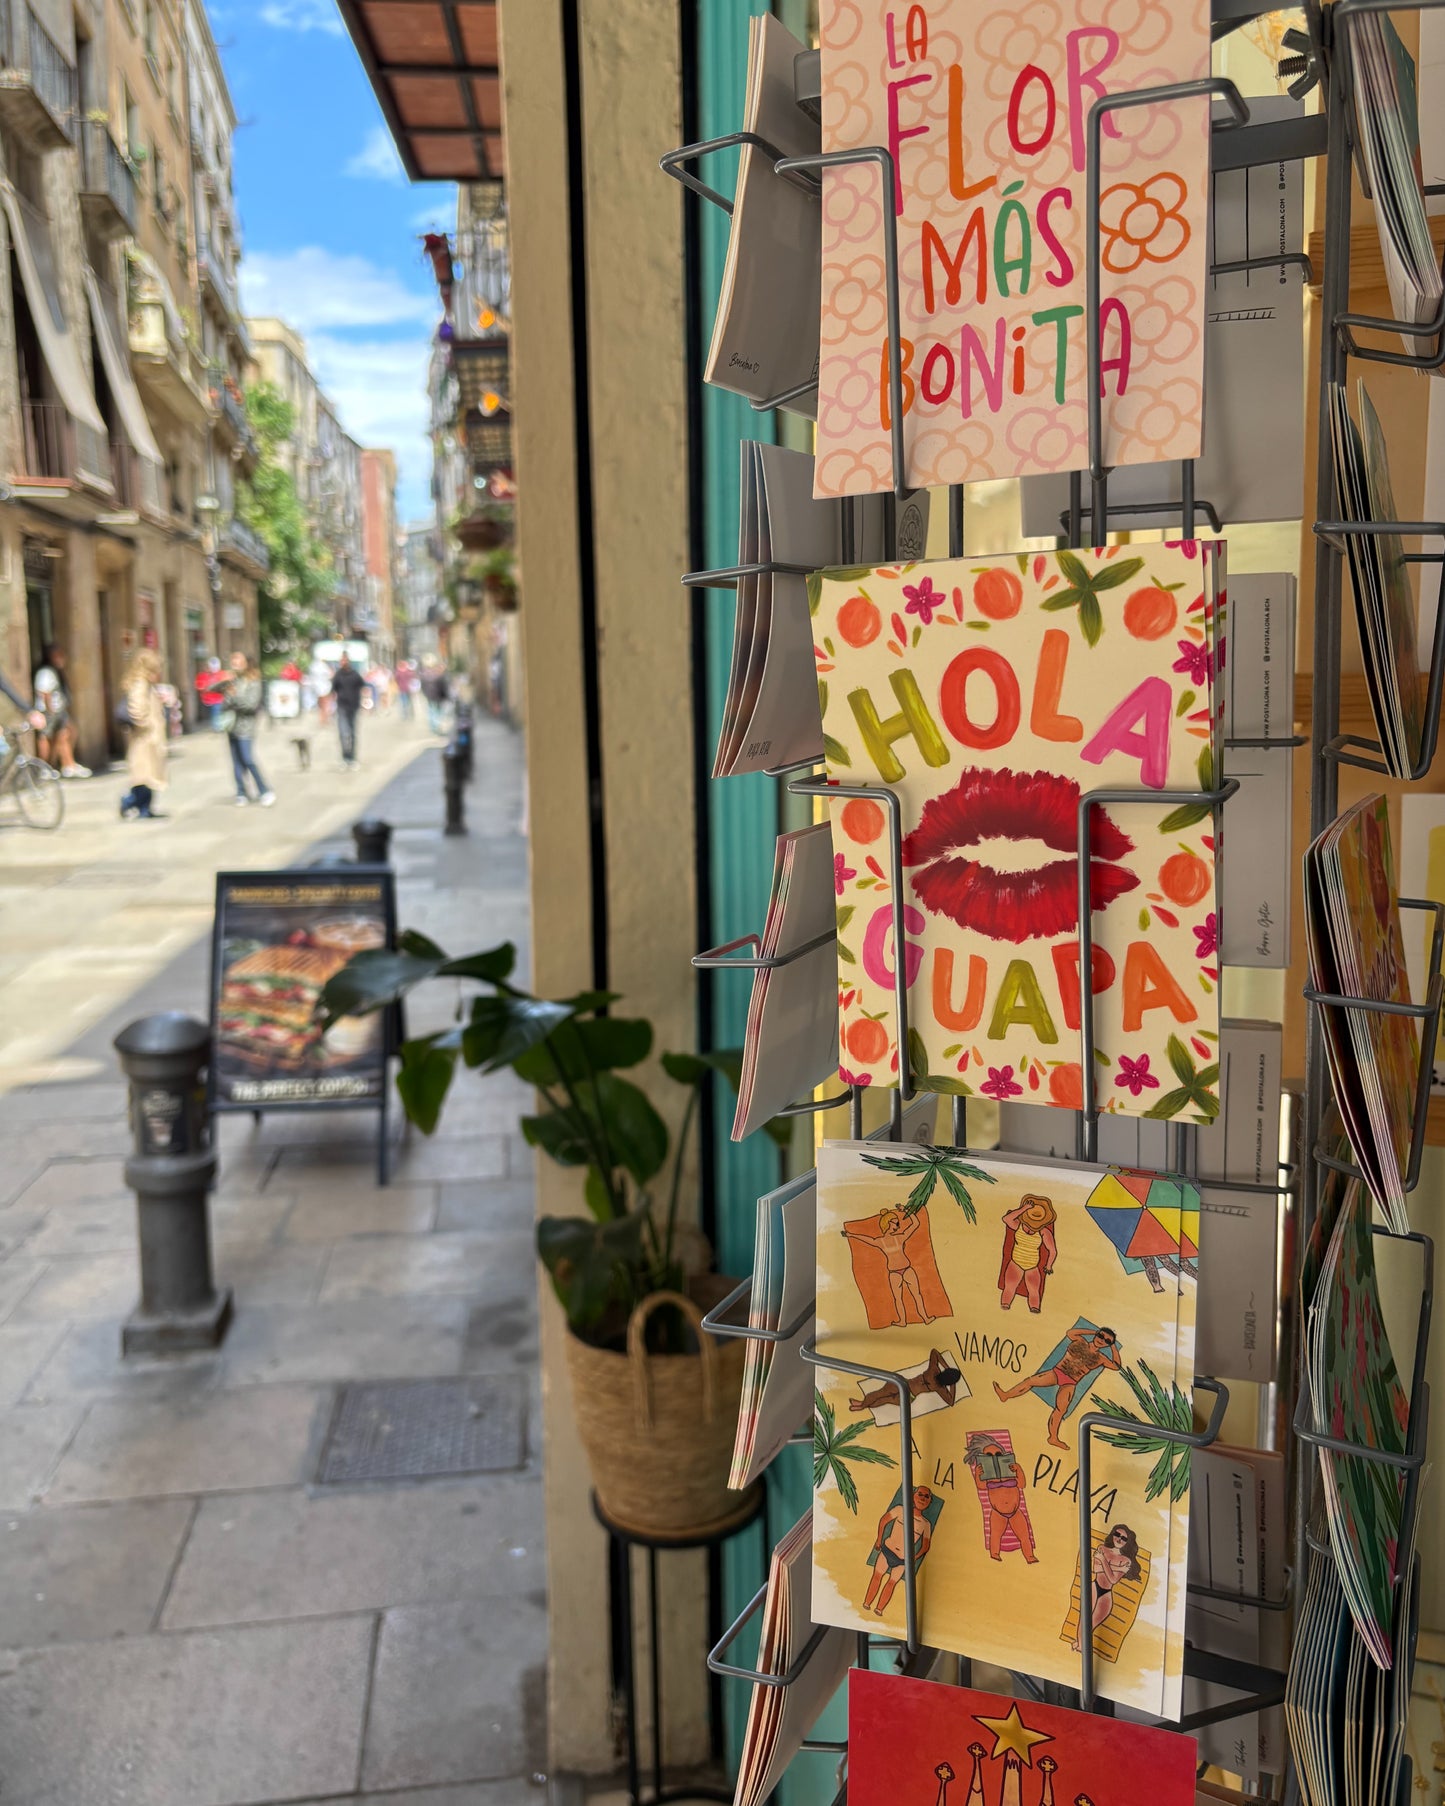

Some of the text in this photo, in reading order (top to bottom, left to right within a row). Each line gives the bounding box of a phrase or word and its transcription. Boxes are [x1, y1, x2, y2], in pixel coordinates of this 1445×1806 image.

[885, 4, 928, 69] LA
[886, 26, 1121, 217] FLOR
[922, 179, 1075, 315] MÁS
[846, 628, 1174, 790] HOLA
[862, 902, 1199, 1046] GUAPA
[954, 1330, 1029, 1374] VAMOS
[933, 1457, 954, 1490] LA
